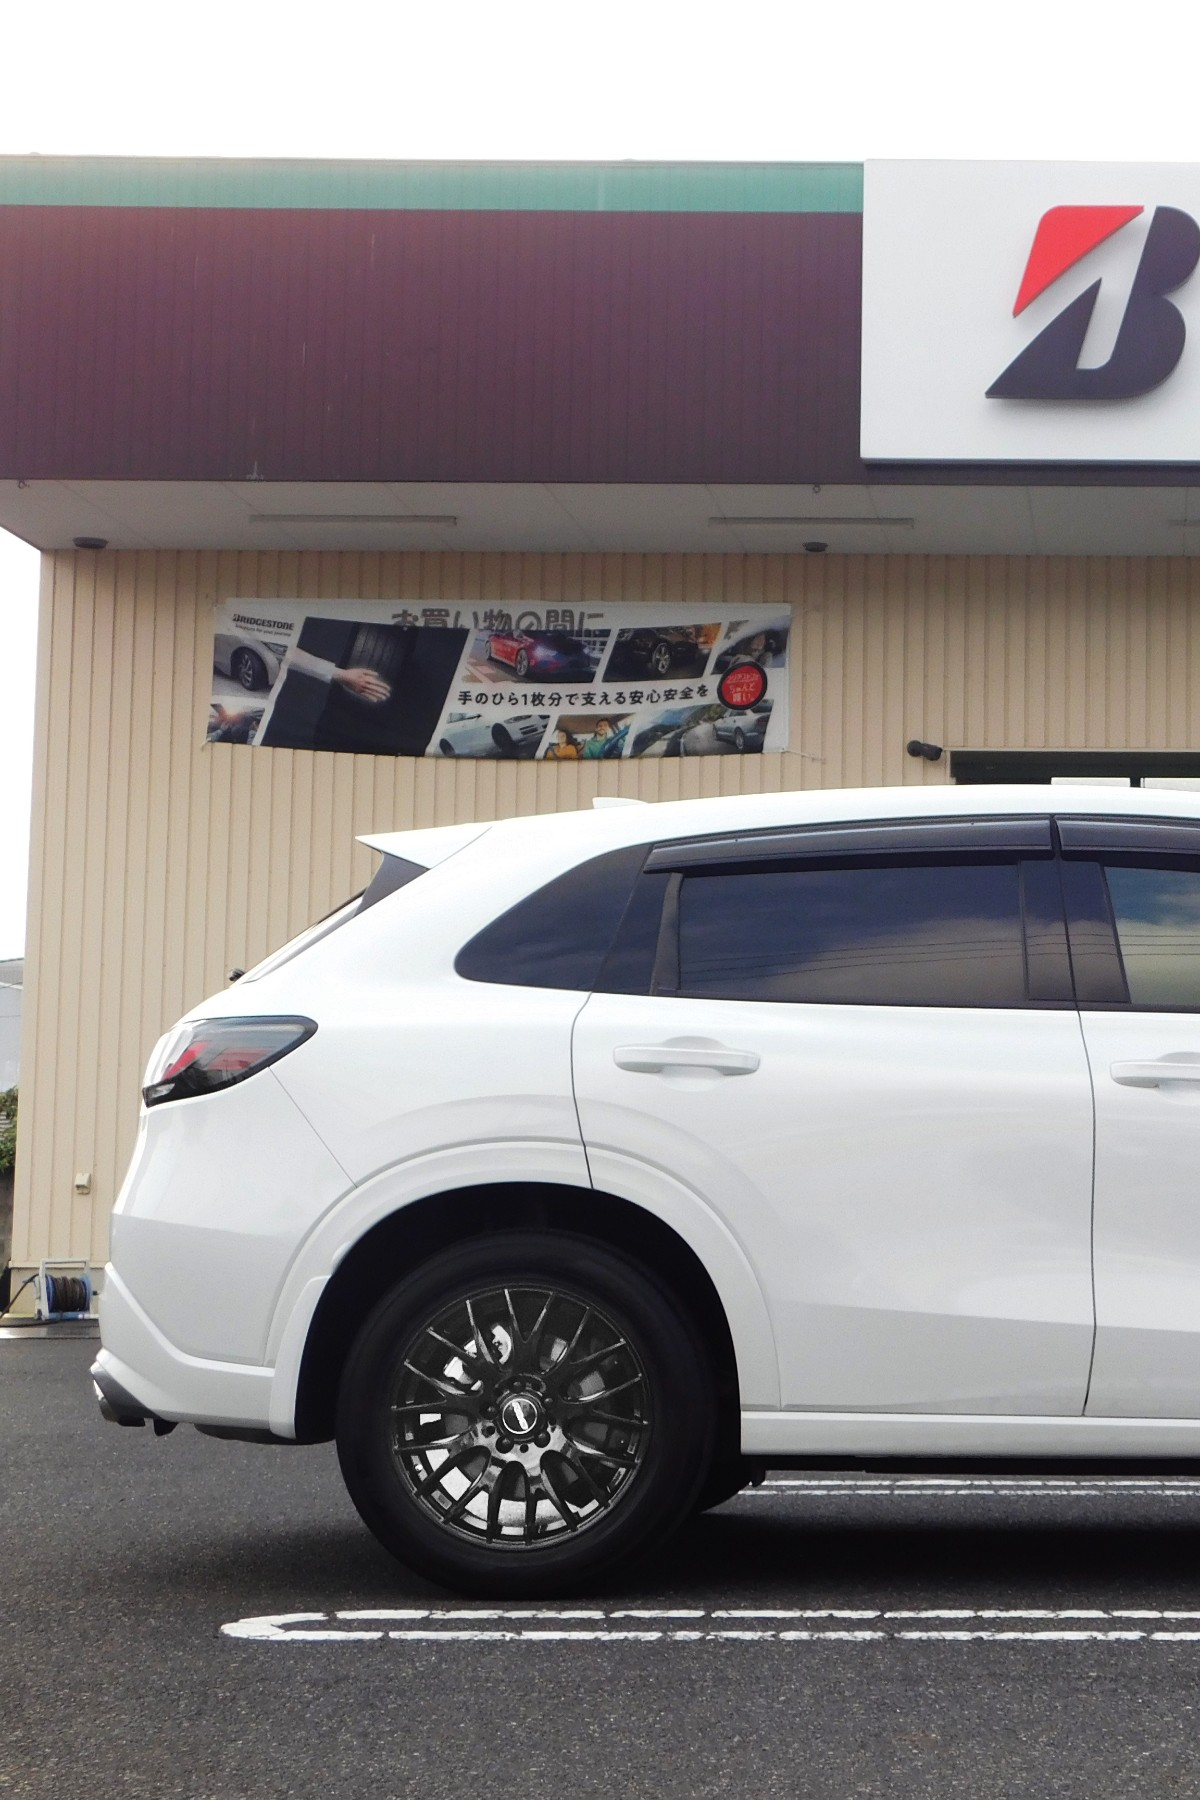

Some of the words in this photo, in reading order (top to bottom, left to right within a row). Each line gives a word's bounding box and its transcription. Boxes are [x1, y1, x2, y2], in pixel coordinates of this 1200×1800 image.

[458, 685, 709, 706] 手のひら1枚分で支える安心安全を
